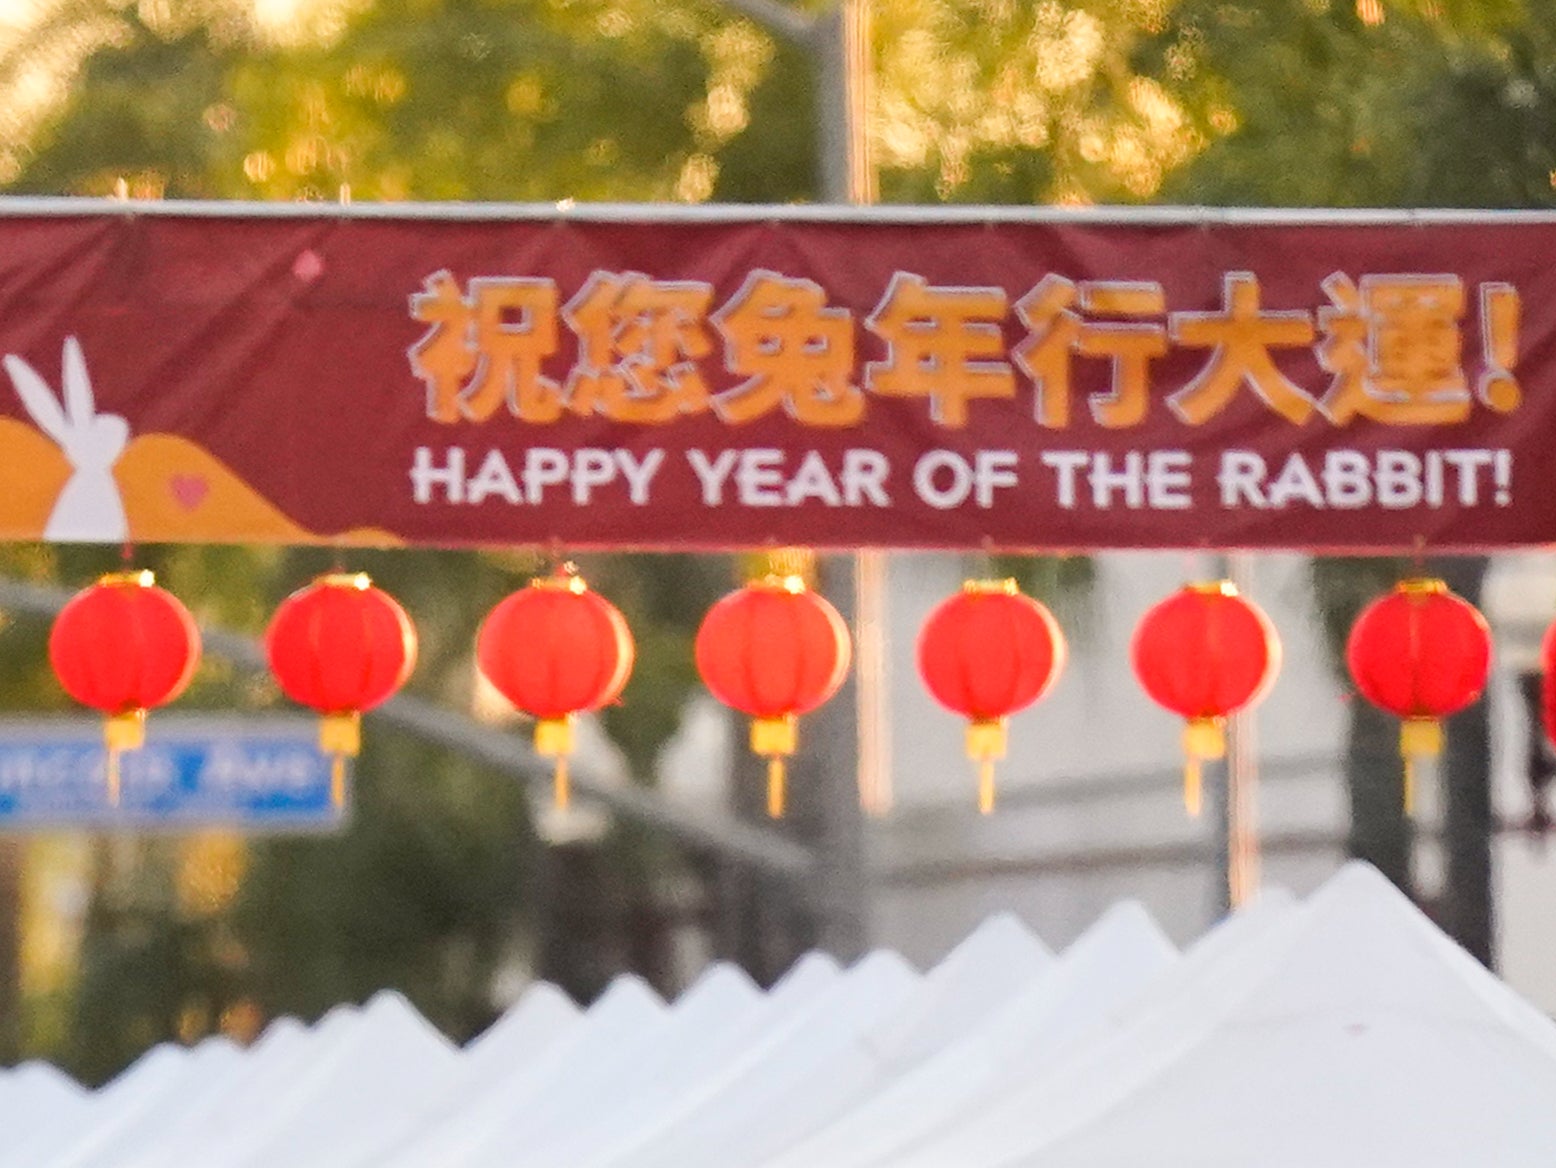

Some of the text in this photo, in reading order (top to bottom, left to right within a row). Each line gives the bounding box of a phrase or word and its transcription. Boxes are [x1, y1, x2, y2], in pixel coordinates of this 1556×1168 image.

[408, 269, 1521, 427] 祝您兔年行大運!
[410, 446, 1513, 509] HAPPY YEAR OF THE RABBIT!
